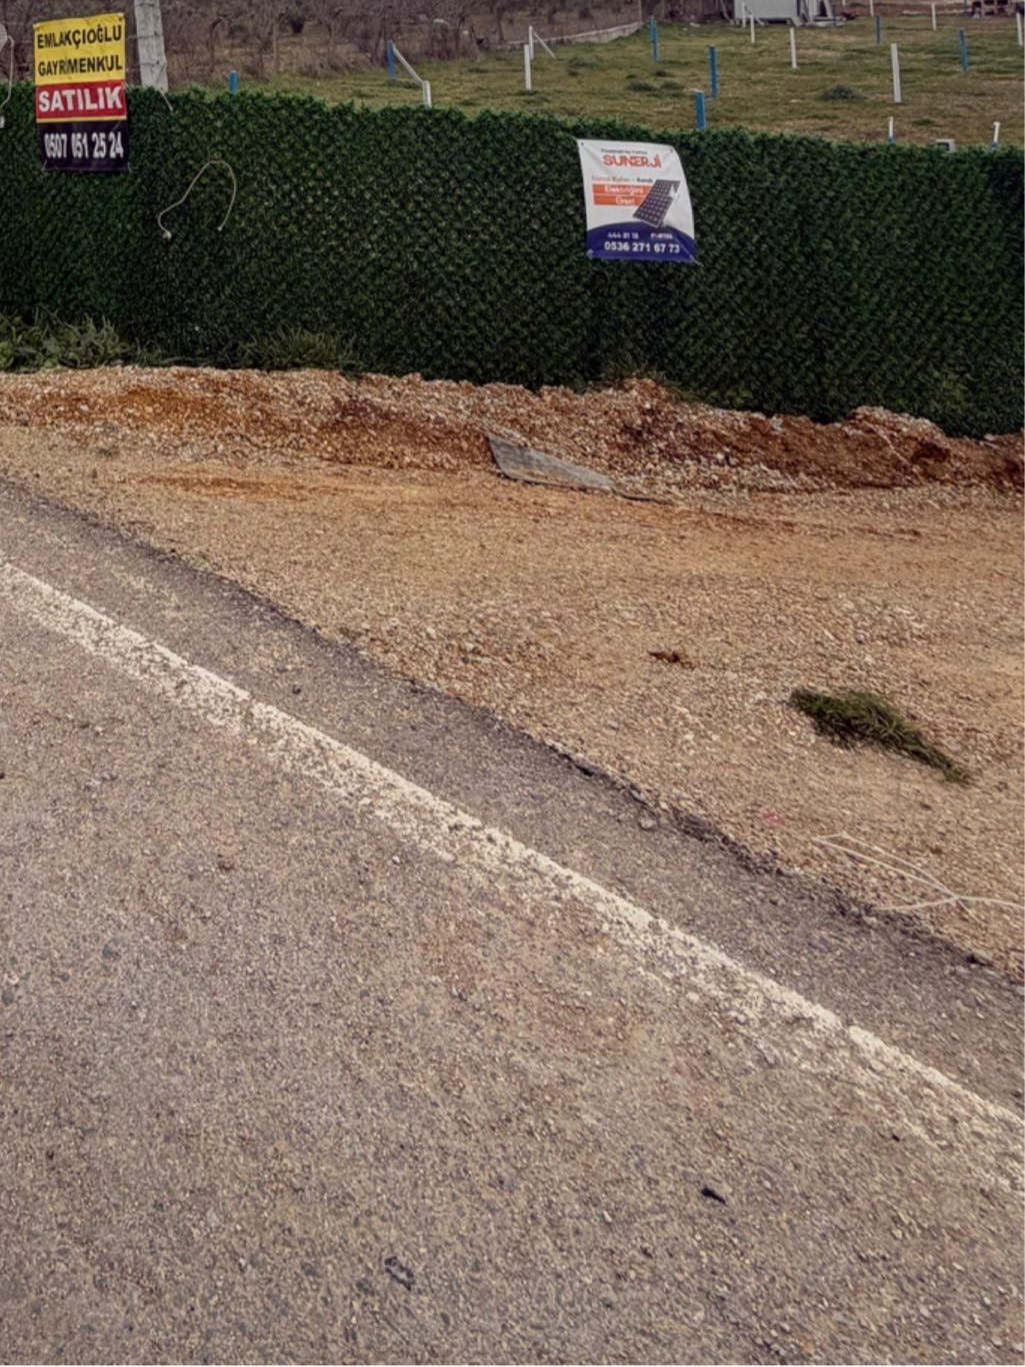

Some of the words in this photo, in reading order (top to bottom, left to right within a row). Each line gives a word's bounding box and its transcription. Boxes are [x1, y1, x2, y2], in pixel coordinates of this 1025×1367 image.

[37, 24, 122, 50] EMLAKÇIOĞLU
[39, 86, 123, 112] SATILIK
[44, 133, 67, 159] 0507
[92, 131, 106, 159] 25
[109, 131, 124, 159] 24
[632, 242, 651, 252] 271
[668, 244, 680, 254] 73
